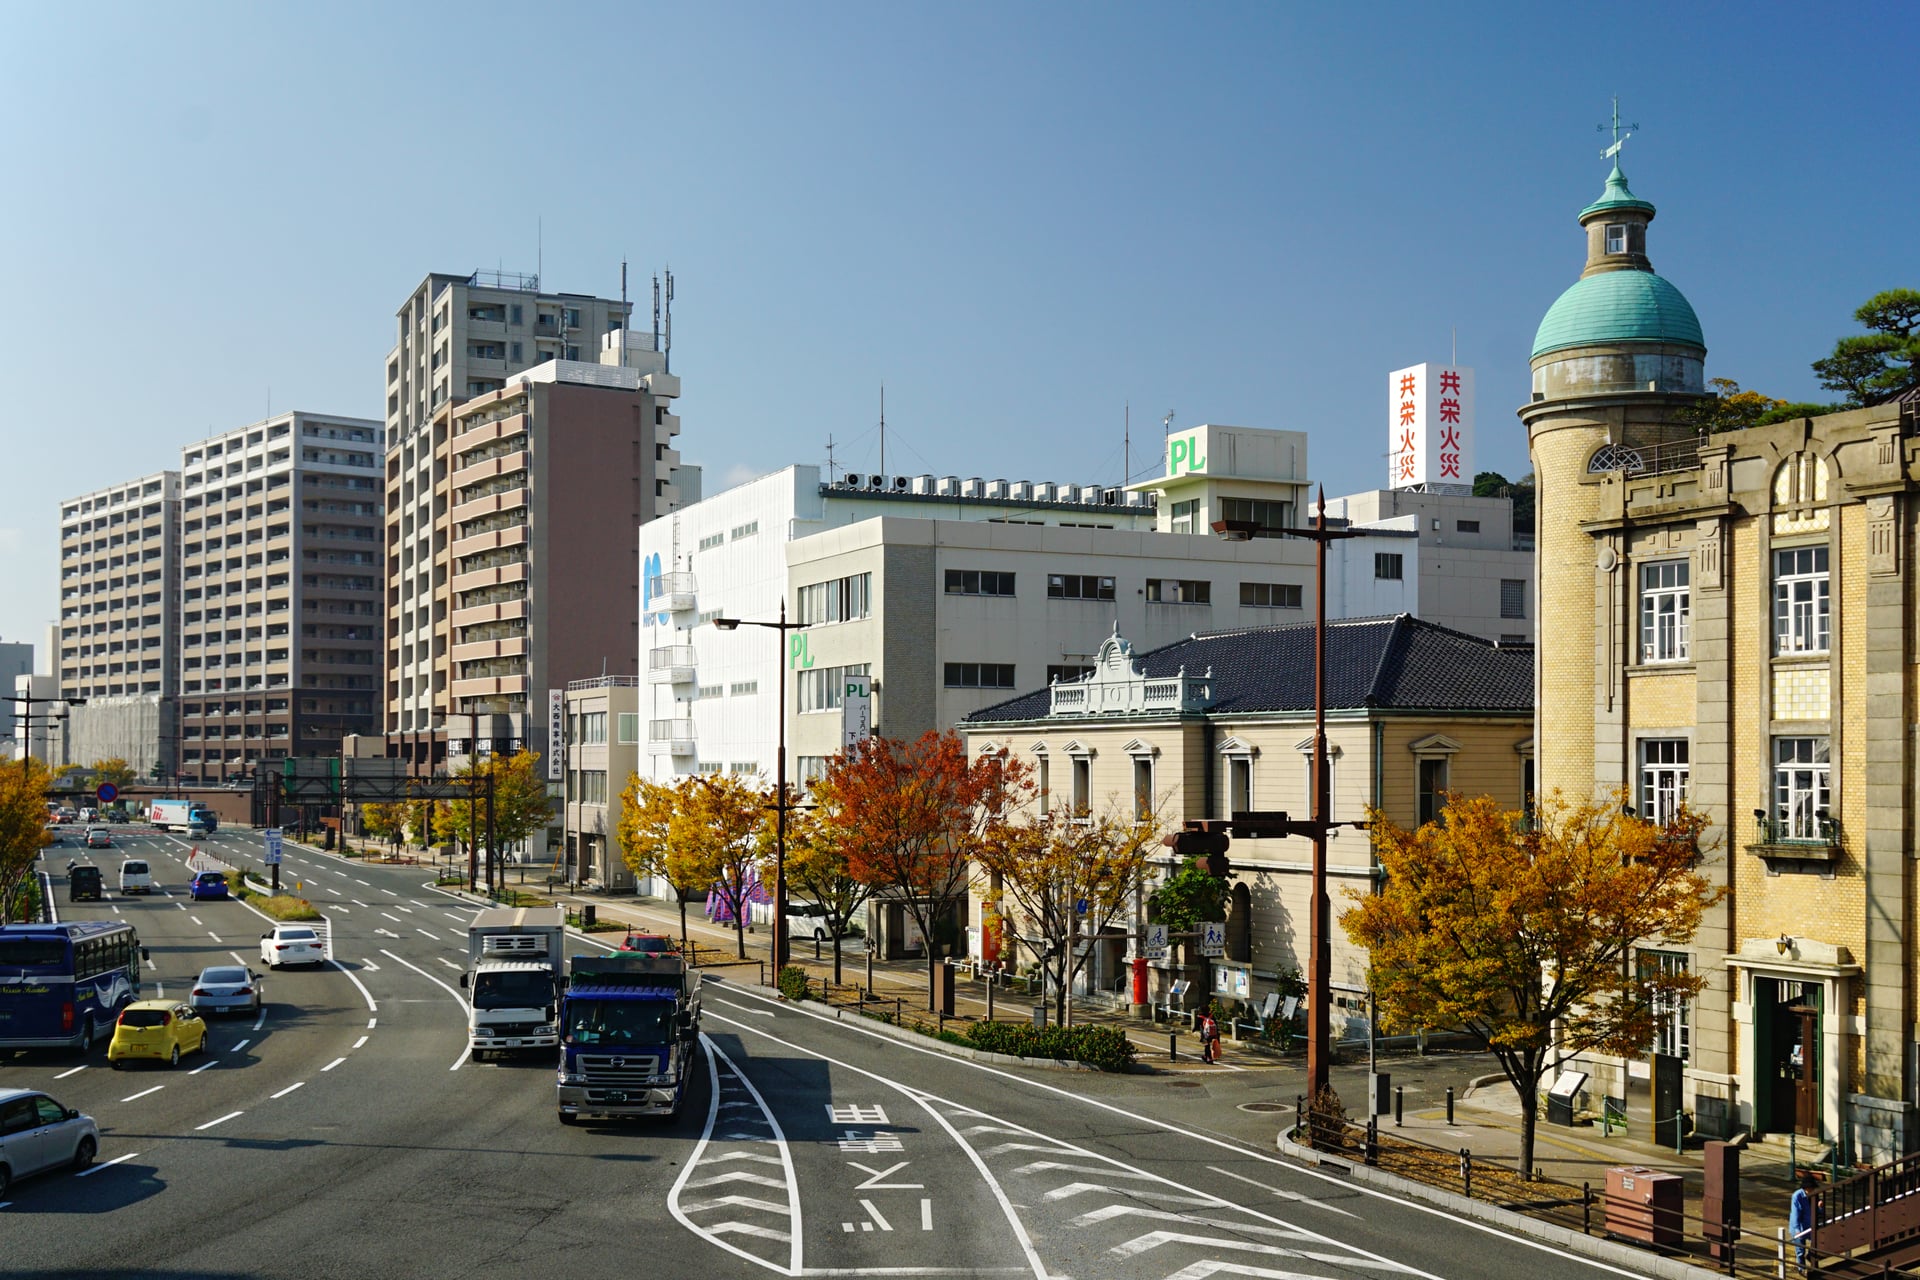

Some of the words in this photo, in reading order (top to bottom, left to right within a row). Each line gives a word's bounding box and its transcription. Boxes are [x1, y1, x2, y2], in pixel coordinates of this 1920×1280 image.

[1171, 436, 1206, 475] PL
[1400, 373, 1415, 480] 共栄火災
[1440, 370, 1460, 479] 共栄火災
[790, 632, 815, 669] PL
[846, 683, 869, 697] PL
[552, 703, 560, 775] 大西商事株式会社
[824, 1104, 933, 1232] バス専用
